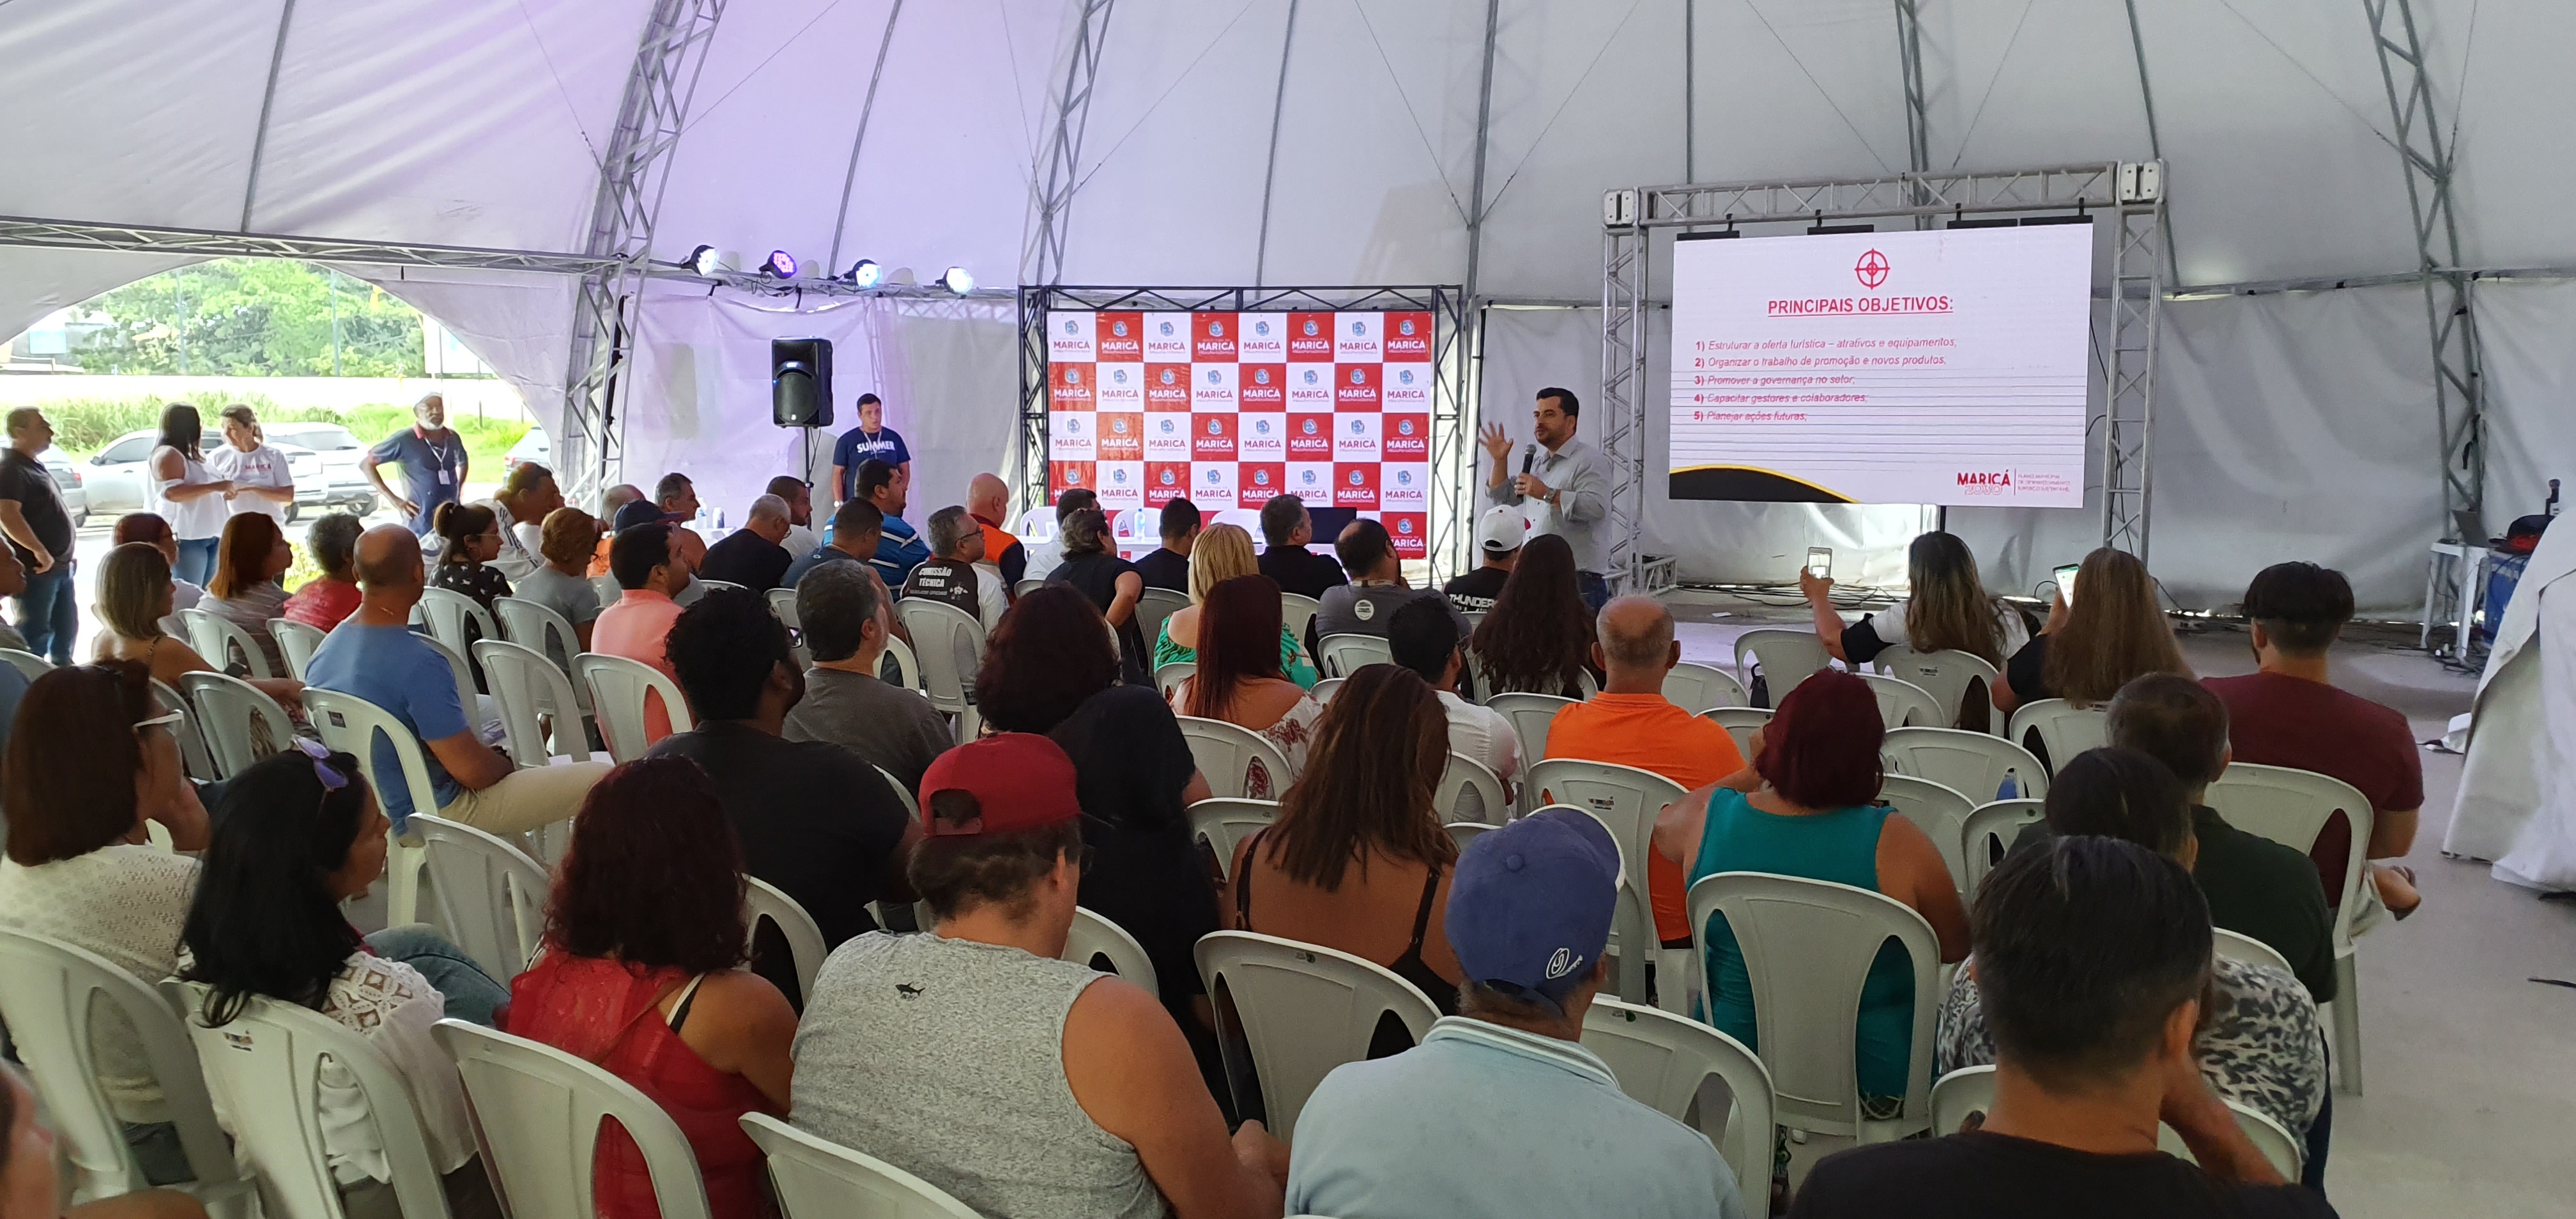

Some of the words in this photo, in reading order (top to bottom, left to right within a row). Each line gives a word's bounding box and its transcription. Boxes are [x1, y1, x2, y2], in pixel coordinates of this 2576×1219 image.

[1768, 298, 1853, 314] PRINCIPAIS
[1859, 296, 1953, 312] OBJETIVOS:
[1054, 341, 1090, 349] MARICÁ
[1102, 341, 1138, 350] MARICÁ
[1149, 342, 1185, 350] MARICÁ
[1198, 342, 1234, 351] MARICÁ
[1244, 341, 1280, 349] MARICÁ
[1292, 341, 1329, 349] MARICÁ
[1340, 341, 1377, 350] MARICÁ
[1388, 341, 1425, 349] MARICÁ
[1696, 341, 1705, 351] 1)
[1708, 340, 1751, 350] Estruturar
[1762, 339, 1788, 349] oferta
[1837, 338, 1876, 348] atrativos
[1695, 358, 1705, 369] 2)
[1708, 357, 1751, 369] Organizar
[1762, 356, 1798, 366] trabalho
[1800, 356, 1811, 365] de
[1814, 356, 1860, 367] promoção
[1872, 356, 1899, 365] novos
[1694, 376, 1704, 386] 3)
[1708, 375, 1751, 385] Promover
[1761, 376, 1813, 386] governança
[1054, 388, 1091, 397] MARICÁ
[1102, 389, 1138, 397] MARICÁ
[1149, 388, 1186, 397] MARICÁ
[1197, 389, 1232, 398] MARICÁ
[1243, 389, 1280, 398] MARICÁ
[1292, 390, 1329, 398] MARICÁ
[1339, 388, 1376, 397] MARICÁ
[1388, 390, 1425, 398] MARICÁ
[1694, 394, 1704, 404] 4)
[1707, 393, 1749, 404] Capacitar
[1751, 394, 1789, 404] gestores
[1694, 411, 1703, 422] 5)
[1707, 411, 1744, 422] Planejar
[857, 441, 895, 453] SUMMER
[1055, 438, 1091, 447] MARICÁ
[1101, 438, 1138, 447] MARICÁ
[1149, 439, 1185, 447] MARICÁ
[1197, 439, 1233, 448] MARICÁ
[1245, 438, 1281, 448] MARICÁ
[1291, 438, 1328, 447] MARICÁ
[1339, 439, 1376, 448] MARICÁ
[1387, 439, 1424, 448] MARICÁ
[1957, 469, 2011, 486] MARICÁ
[1101, 488, 1137, 497] MARICÁ
[1338, 489, 1374, 498] MARICÁ
[1386, 490, 1422, 498] MARICÁ
[919, 578, 944, 587] TÉCNICA
